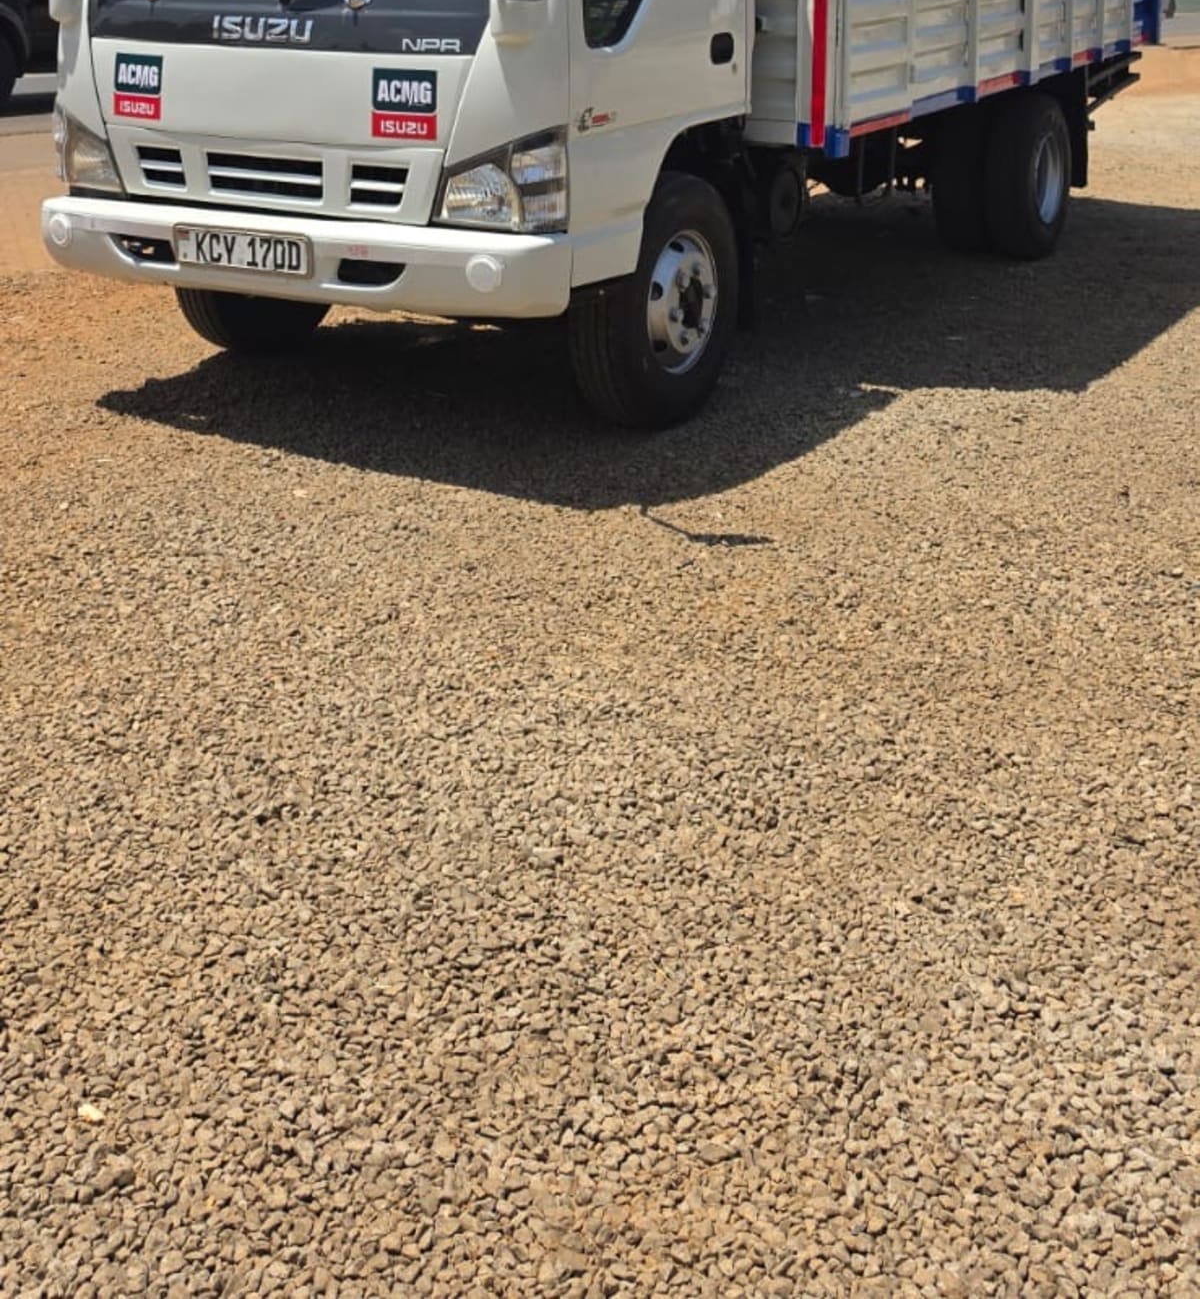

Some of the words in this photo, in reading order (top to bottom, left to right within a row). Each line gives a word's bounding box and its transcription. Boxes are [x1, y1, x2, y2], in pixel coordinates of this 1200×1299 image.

[212, 14, 314, 43] ISUZU
[402, 38, 461, 53] NPR
[118, 62, 159, 88] ACMG
[377, 79, 433, 106] ACMG
[120, 100, 155, 116] ISUZU
[380, 119, 428, 135] ISUZU
[195, 231, 236, 265] KCY
[246, 236, 302, 271] 170D
